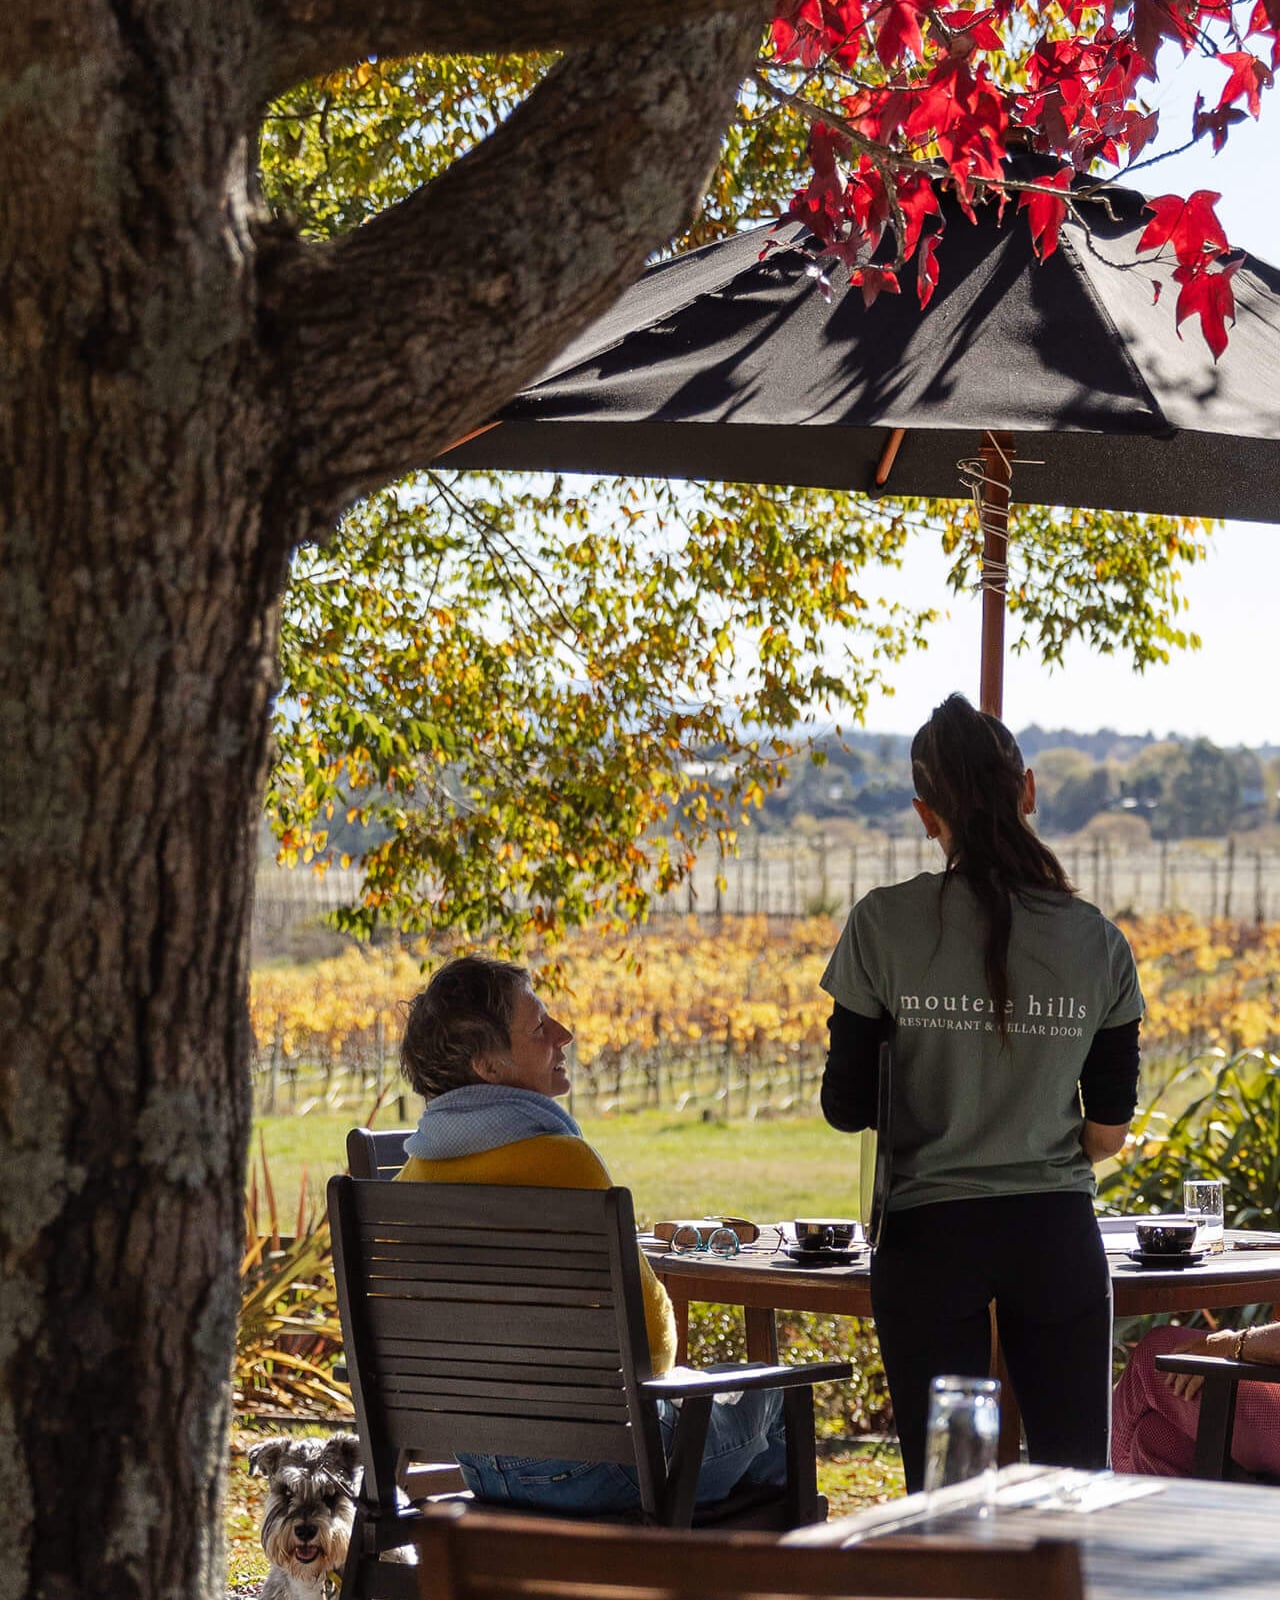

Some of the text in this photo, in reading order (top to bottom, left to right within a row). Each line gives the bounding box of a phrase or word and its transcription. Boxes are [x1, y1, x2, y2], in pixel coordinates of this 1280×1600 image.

[1028, 994, 1087, 1020] hills
[899, 1016, 1083, 1038] RESTAURANT & ELLAR DOOR
